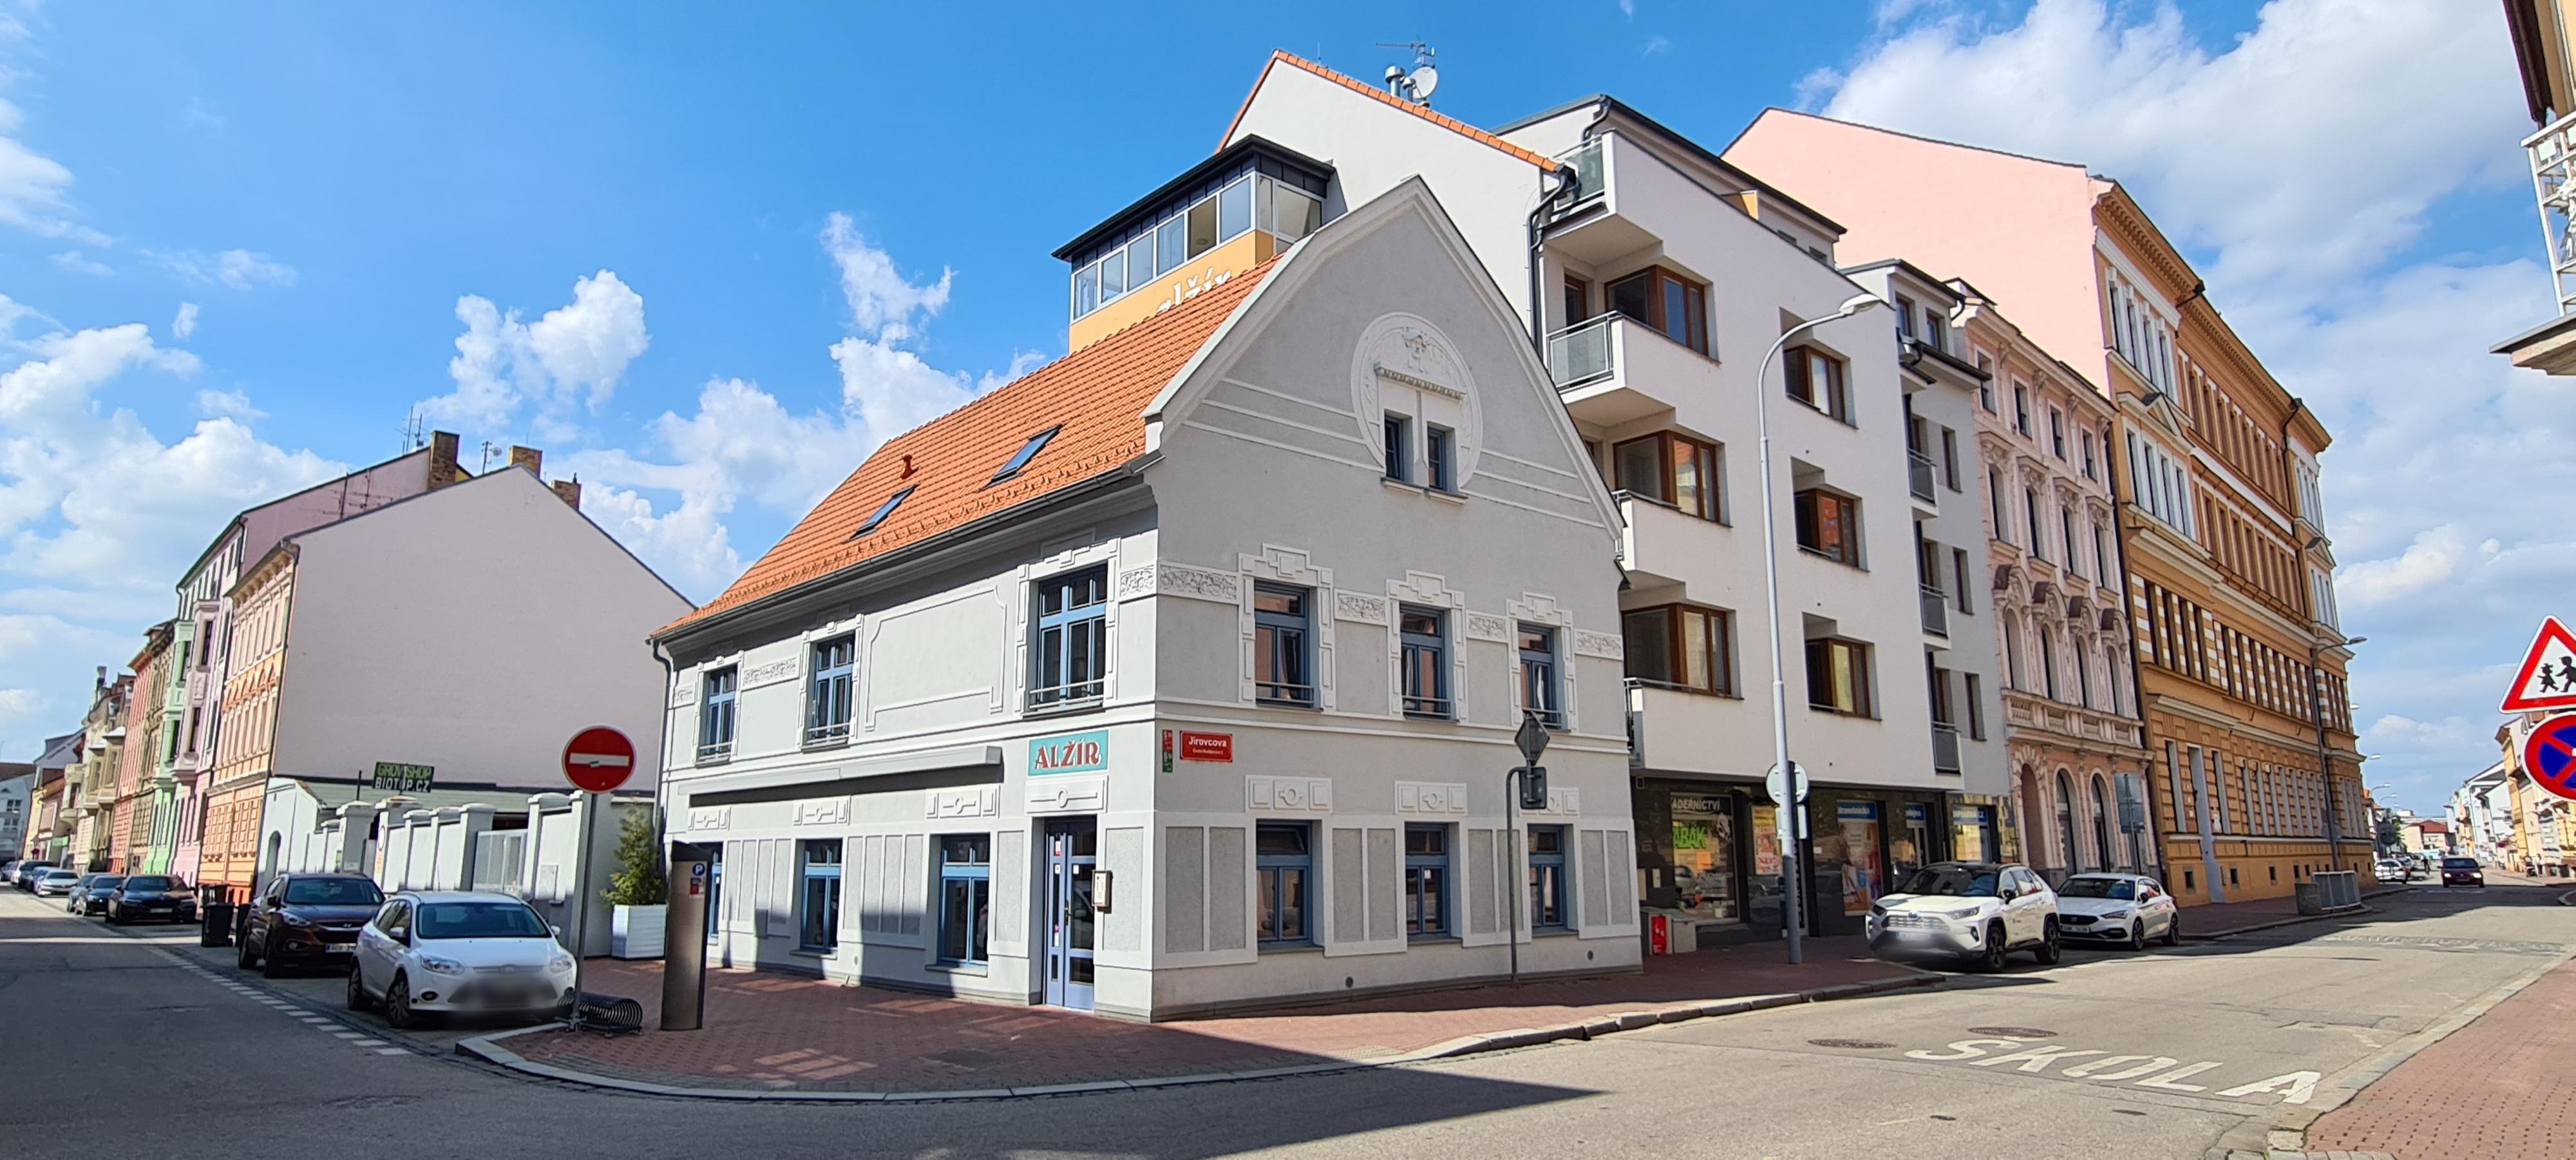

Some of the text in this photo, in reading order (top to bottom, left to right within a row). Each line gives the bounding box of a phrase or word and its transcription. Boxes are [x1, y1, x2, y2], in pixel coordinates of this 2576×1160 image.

[1035, 737, 1102, 770] ALŽÍR
[1188, 736, 1227, 747] Jirovcova
[1904, 1036, 2321, 1104] ŠKOLA
